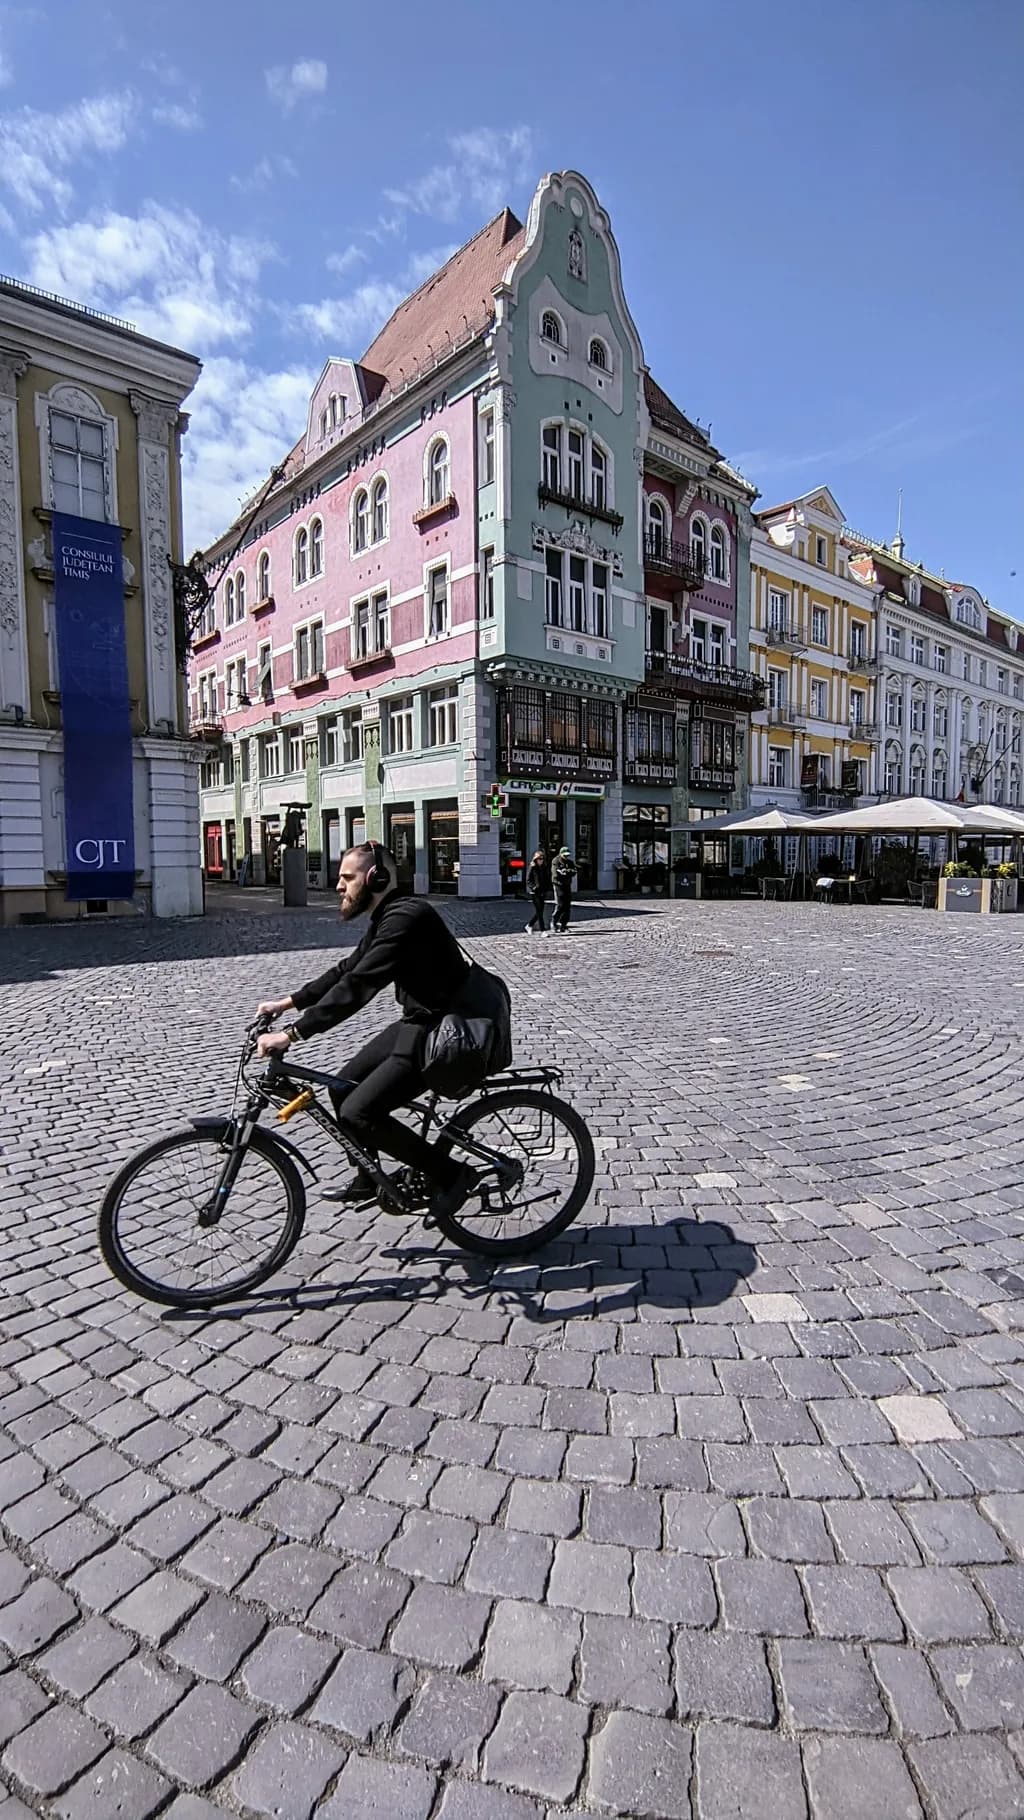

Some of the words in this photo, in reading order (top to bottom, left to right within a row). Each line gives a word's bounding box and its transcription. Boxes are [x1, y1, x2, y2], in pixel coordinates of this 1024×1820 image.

[61, 546, 115, 564] CONSILIUL
[75, 839, 126, 869] CJT
[308, 1108, 377, 1173] ROCKRIDER
